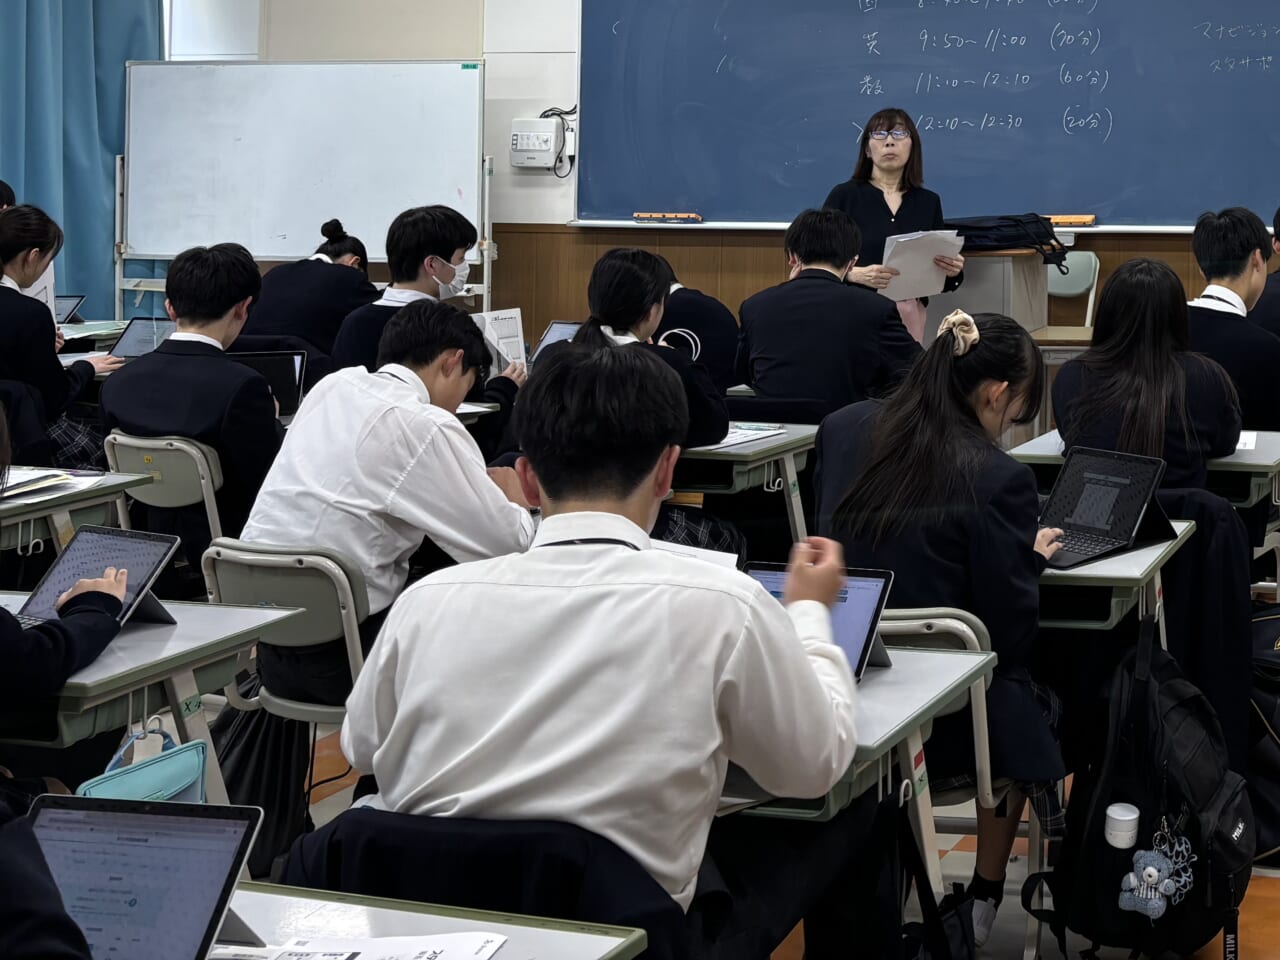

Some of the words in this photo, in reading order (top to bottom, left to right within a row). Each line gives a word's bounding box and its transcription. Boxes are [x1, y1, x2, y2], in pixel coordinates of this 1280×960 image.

[862, 31, 881, 56] 英
[859, 74, 885, 96] 数
[1232, 822, 1245, 841] MILK
[1226, 934, 1236, 960] MILK
